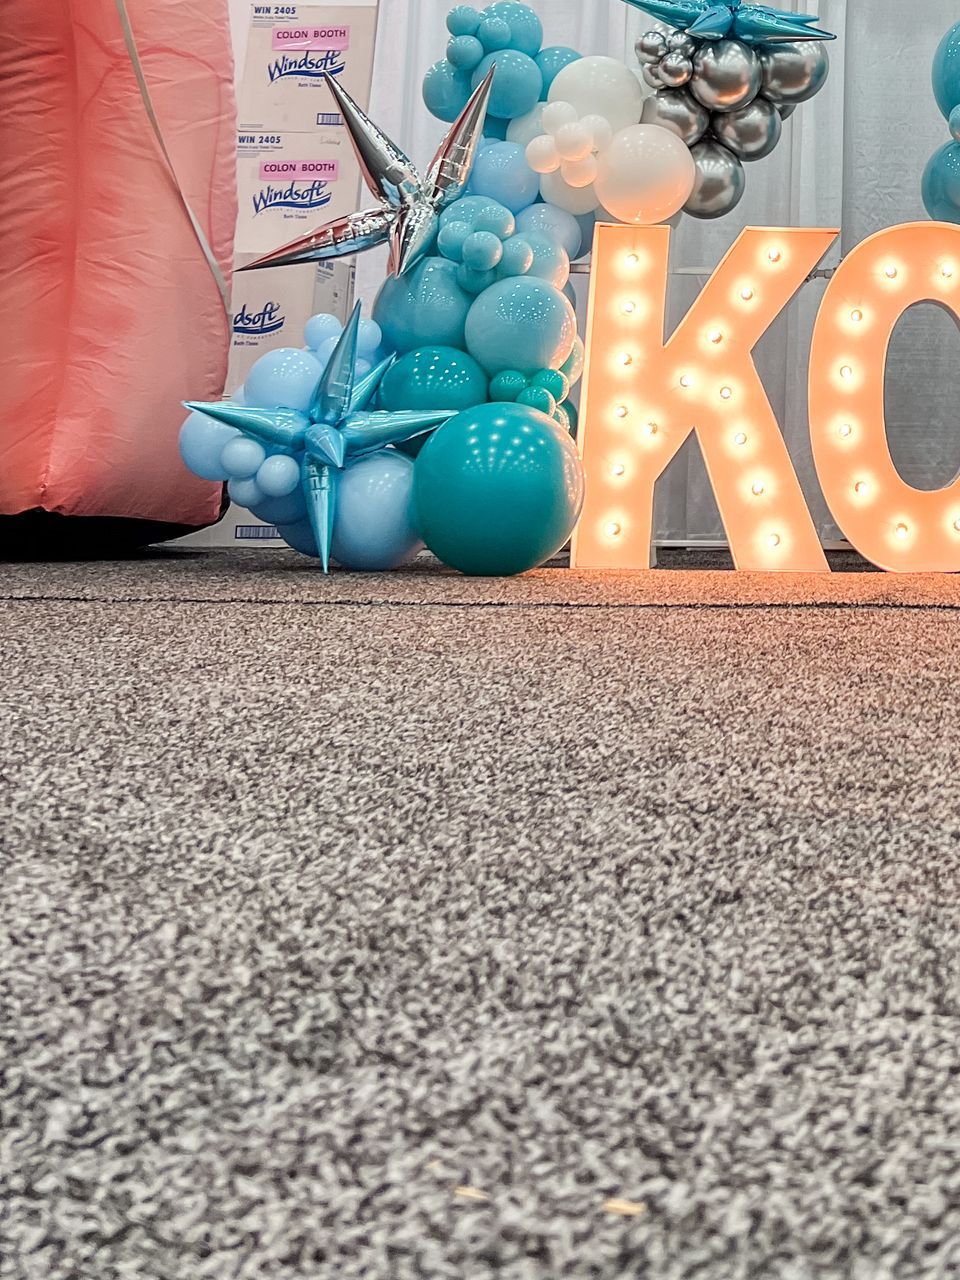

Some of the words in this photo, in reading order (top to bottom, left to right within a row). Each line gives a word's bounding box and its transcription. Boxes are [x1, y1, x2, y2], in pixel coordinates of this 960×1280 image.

[254, 6, 272, 15] WIN
[274, 6, 297, 15] 2405
[276, 30, 309, 40] COLON
[313, 29, 346, 39] BOOTH
[267, 50, 342, 82] Windsoft
[238, 135, 256, 144] WIN
[258, 135, 281, 144] 2405
[263, 163, 297, 173] COLON
[301, 163, 335, 172] BOOTH
[252, 180, 328, 215] Windsoft
[232, 301, 282, 329] dsoft
